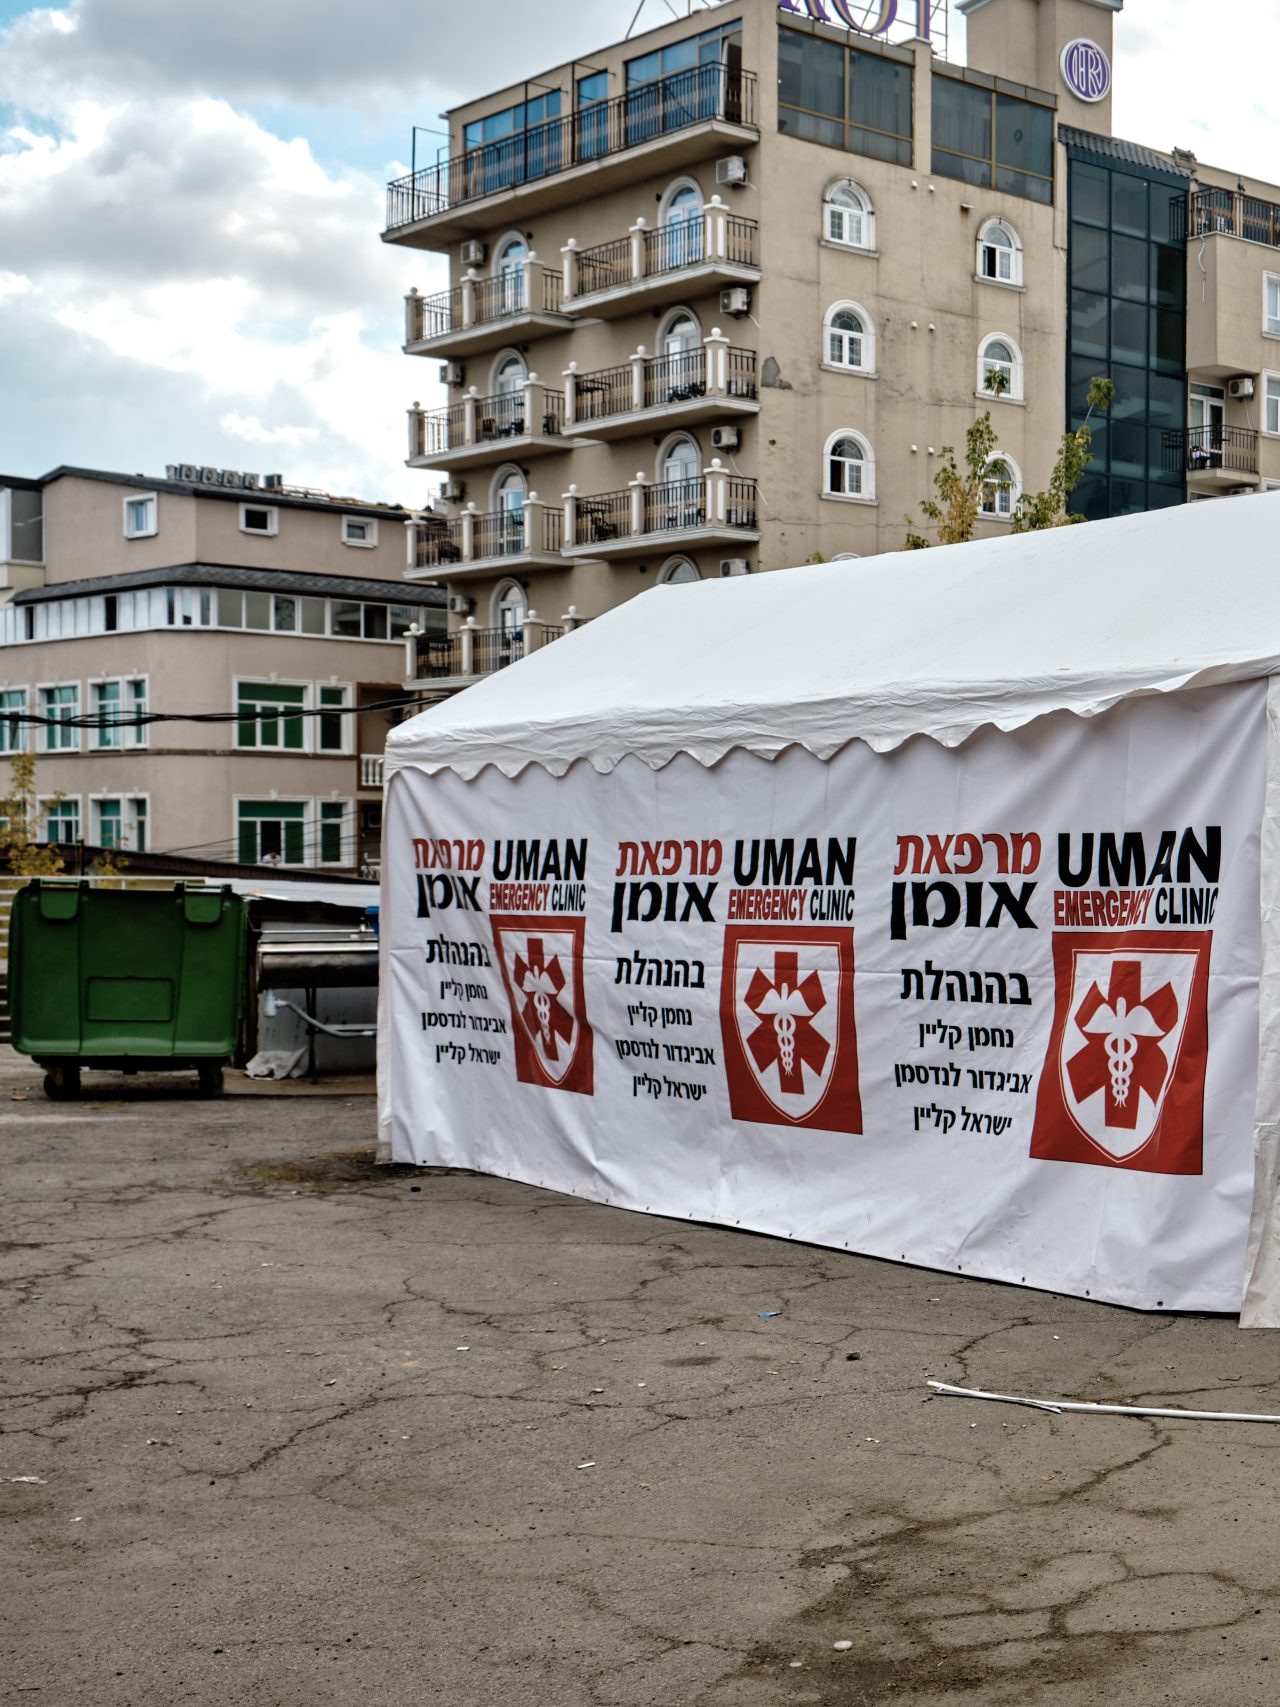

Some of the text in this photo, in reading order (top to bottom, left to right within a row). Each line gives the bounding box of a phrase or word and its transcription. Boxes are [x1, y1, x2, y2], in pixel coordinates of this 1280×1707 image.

[412, 838, 485, 871] מרפאת
[493, 838, 588, 881] UMAN
[616, 839, 723, 877] מרפאת
[733, 837, 857, 886] UMAN
[893, 832, 1042, 876] מרפאת
[1057, 825, 1222, 888] UMAN
[416, 874, 482, 918] אומן
[489, 883, 586, 912] EMERGENCY CLINIC
[610, 881, 719, 933] אומן
[727, 888, 855, 921] EMERGENCY CLINIC
[890, 881, 1039, 941] אומן
[1053, 887, 1219, 927] EMERGENCY CLINIC
[426, 933, 492, 968] בהנהלת
[614, 950, 705, 988] בהנהלת
[900, 960, 1032, 1005] בהנהלת
[441, 978, 488, 1002] נחמן קליין
[422, 1011, 507, 1034] אביגדור לנדסמן
[627, 1001, 692, 1029] נחמן קליין
[615, 1038, 716, 1065] אביגדור לנדסמן
[919, 1019, 1014, 1051] נחמן קליין
[436, 1041, 500, 1065] ישראל קליין
[633, 1073, 707, 1101] ישראל קליין
[894, 1062, 1033, 1094] אביגדור לנדסמן
[914, 1102, 1013, 1136] ישראל קליין
